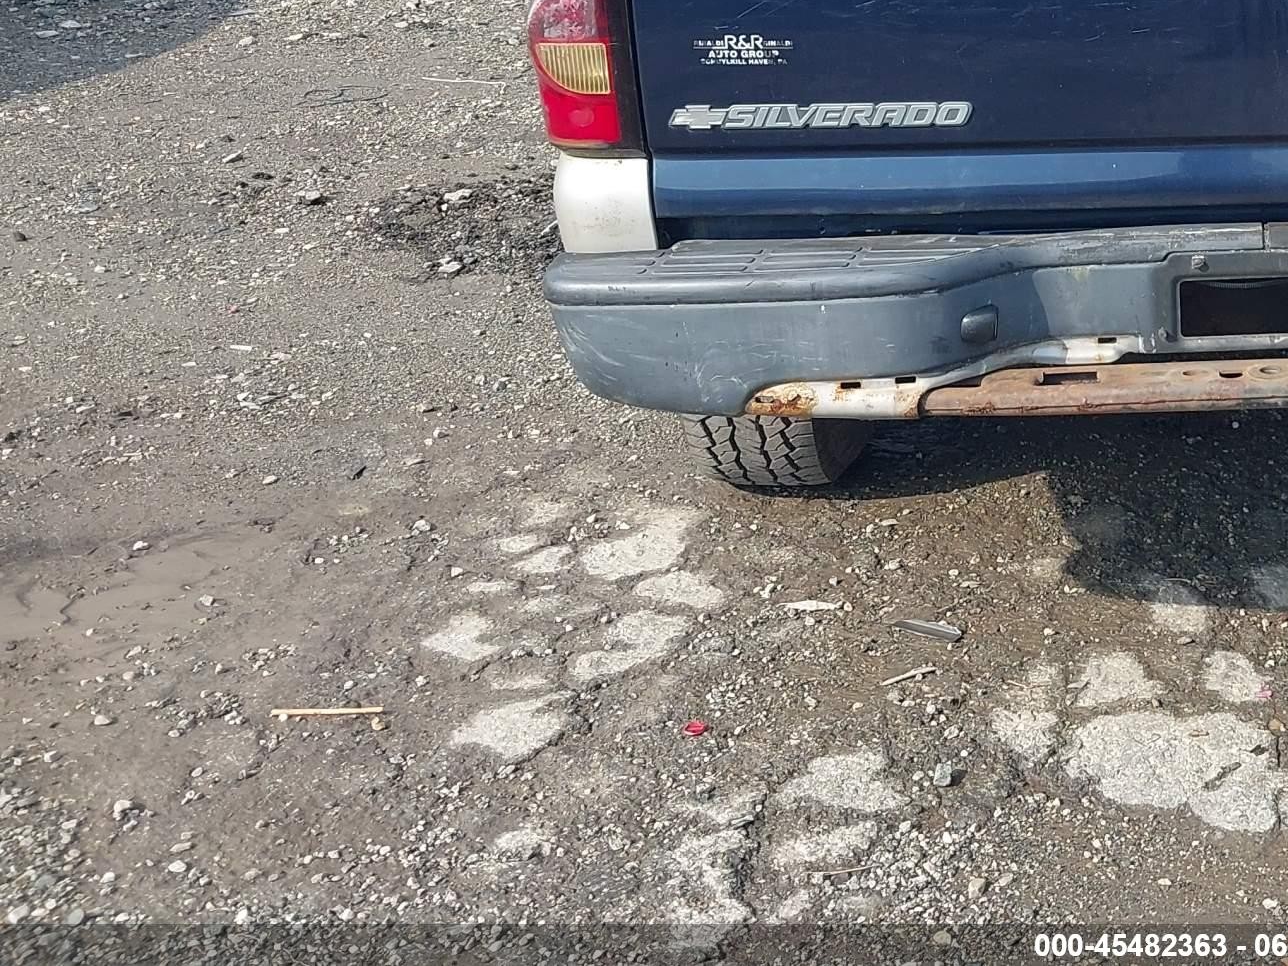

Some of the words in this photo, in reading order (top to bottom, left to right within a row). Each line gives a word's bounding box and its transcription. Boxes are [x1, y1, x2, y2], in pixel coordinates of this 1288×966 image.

[724, 34, 763, 49] R&R
[708, 50, 738, 58] AUTO
[740, 50, 779, 58] GROUP
[721, 101, 973, 129] SILVERADO
